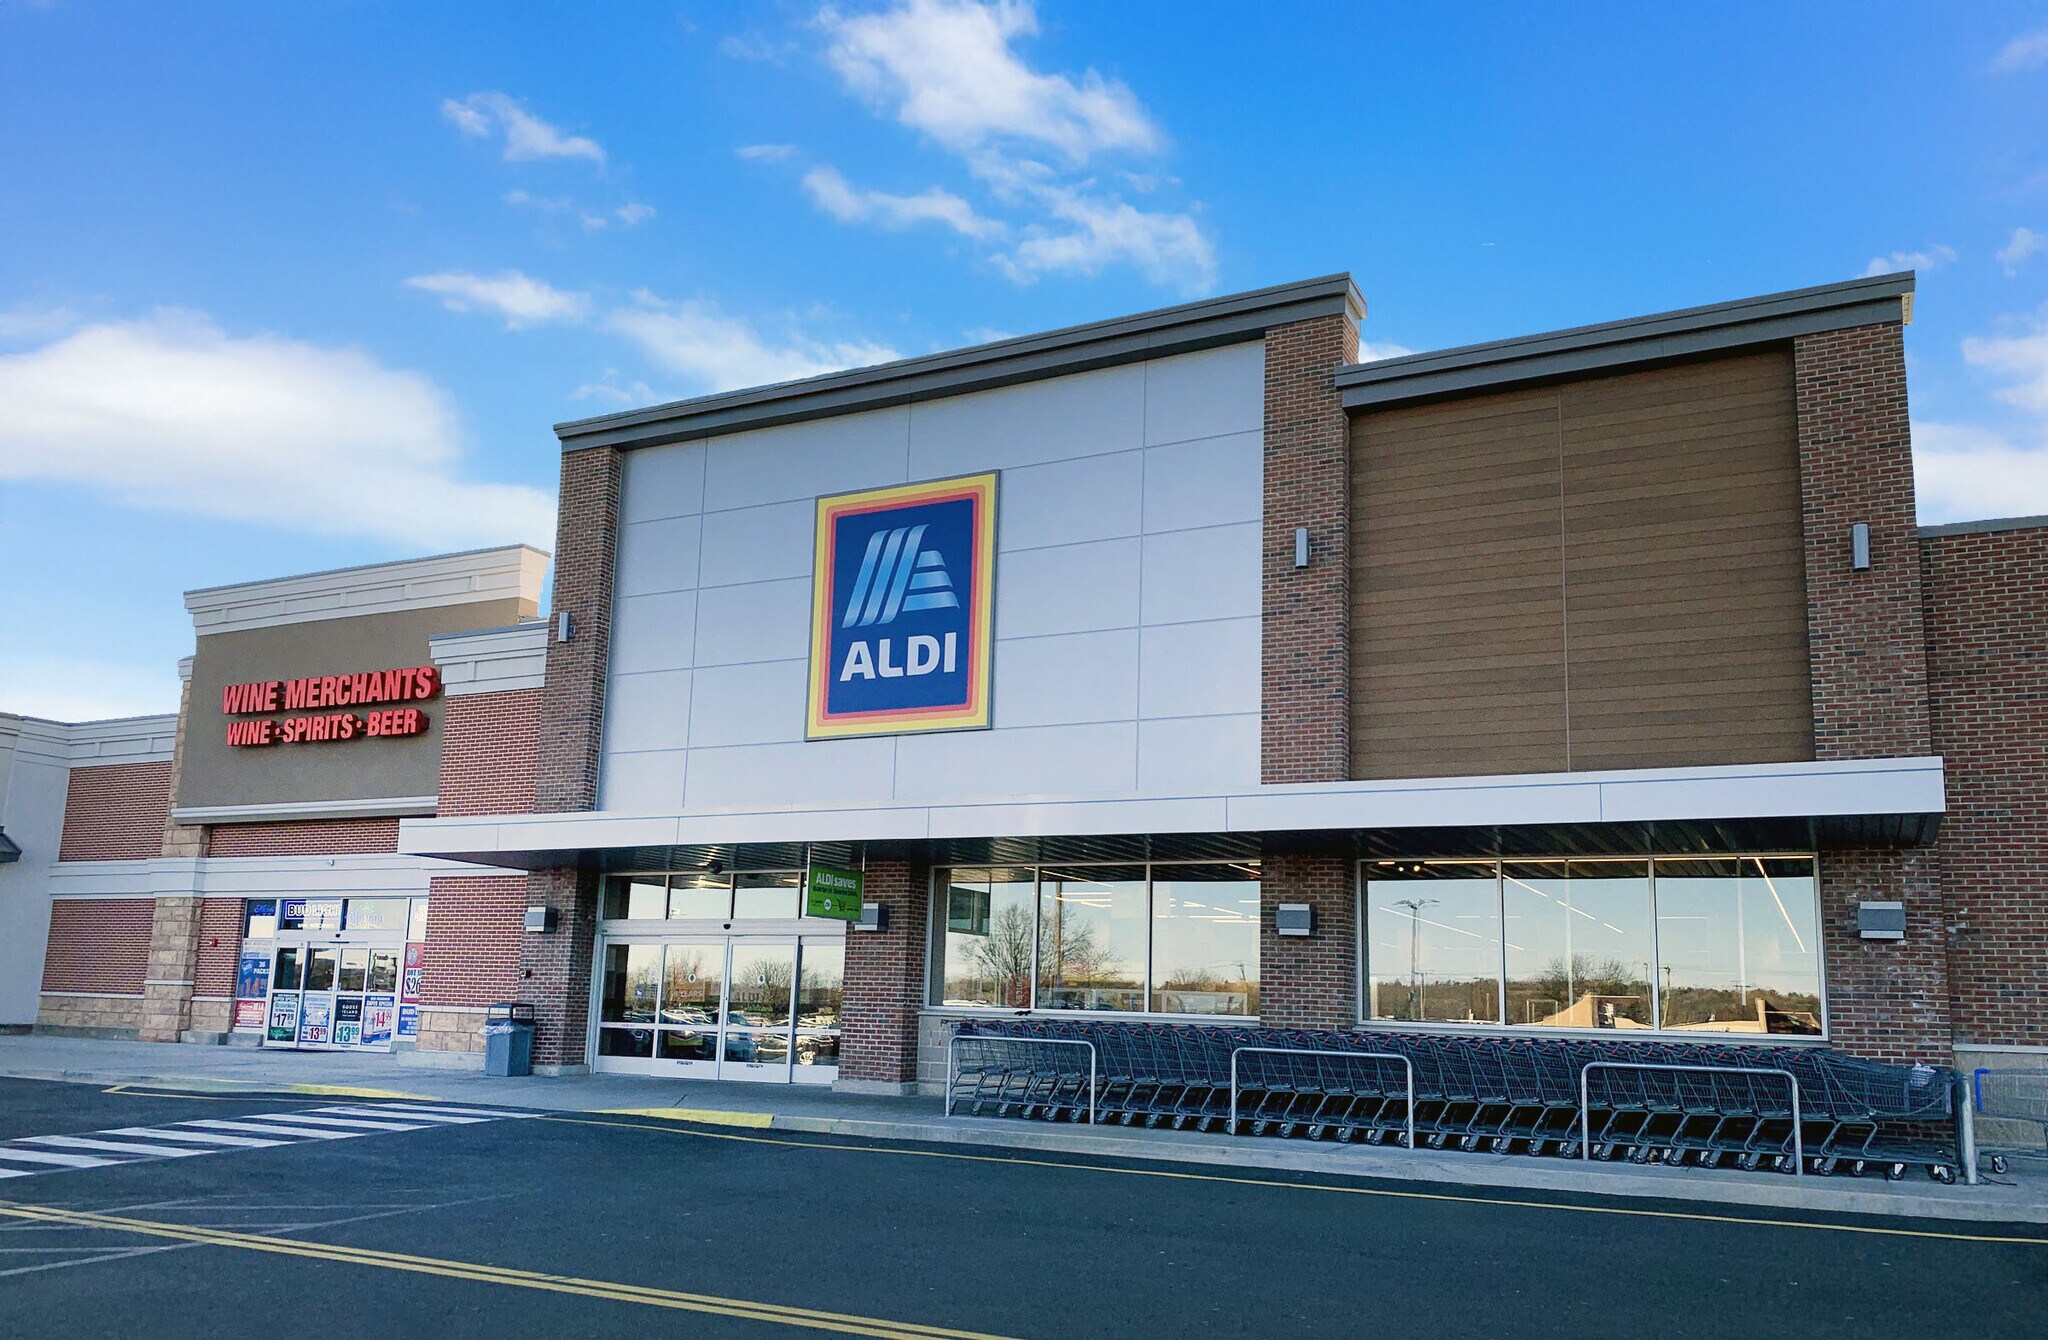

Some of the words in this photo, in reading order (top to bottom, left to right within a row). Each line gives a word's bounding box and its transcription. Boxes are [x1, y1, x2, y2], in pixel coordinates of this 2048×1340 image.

[839, 632, 957, 682] ALDI
[222, 681, 280, 715] WINE
[284, 666, 437, 710] MERCHANTS
[226, 719, 273, 746] WINE
[282, 714, 354, 743] SPIRITS
[366, 708, 421, 738] BEER
[816, 873, 834, 885] ALDI
[834, 877, 856, 889] saves
[288, 904, 310, 916] BUD
